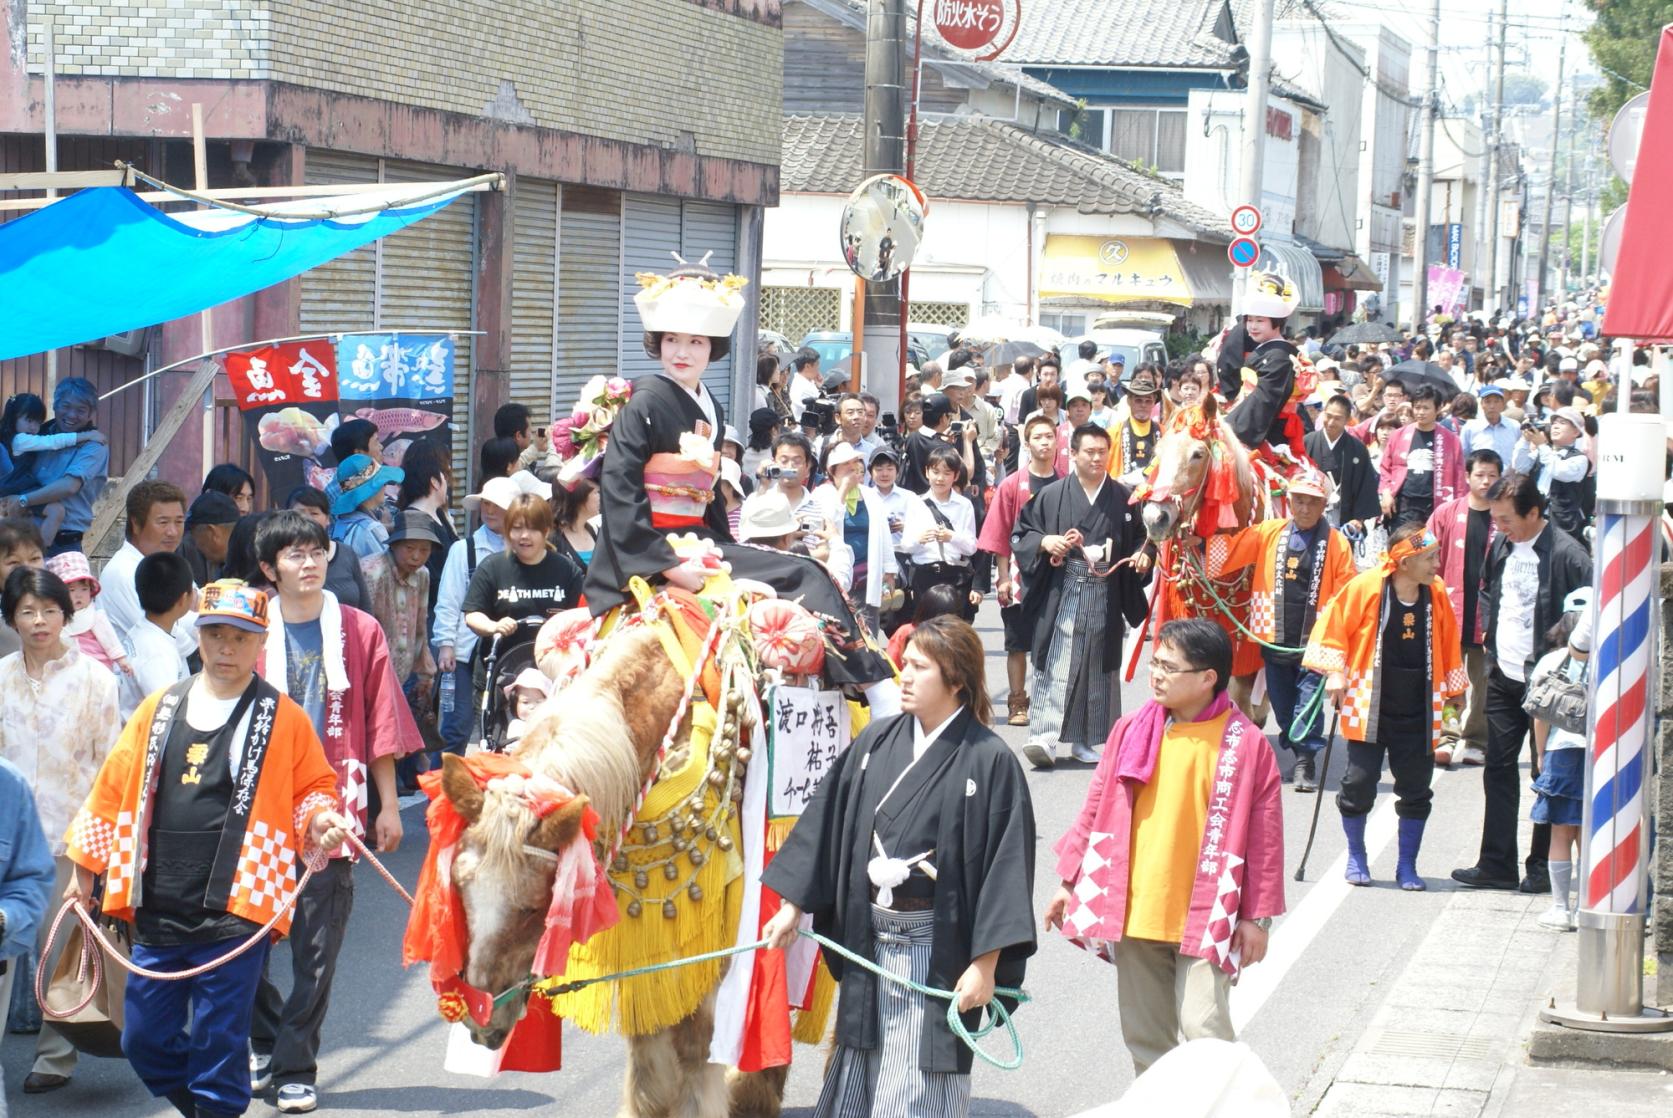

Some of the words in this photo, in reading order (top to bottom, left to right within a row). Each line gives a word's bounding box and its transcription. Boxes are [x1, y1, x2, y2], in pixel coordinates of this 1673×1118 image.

[936, 0, 1001, 32] 防火水そう
[1238, 213, 1255, 228] 30
[532, 585, 566, 602] METAL
[1200, 720, 1245, 876] 志布志市商工会青年部
